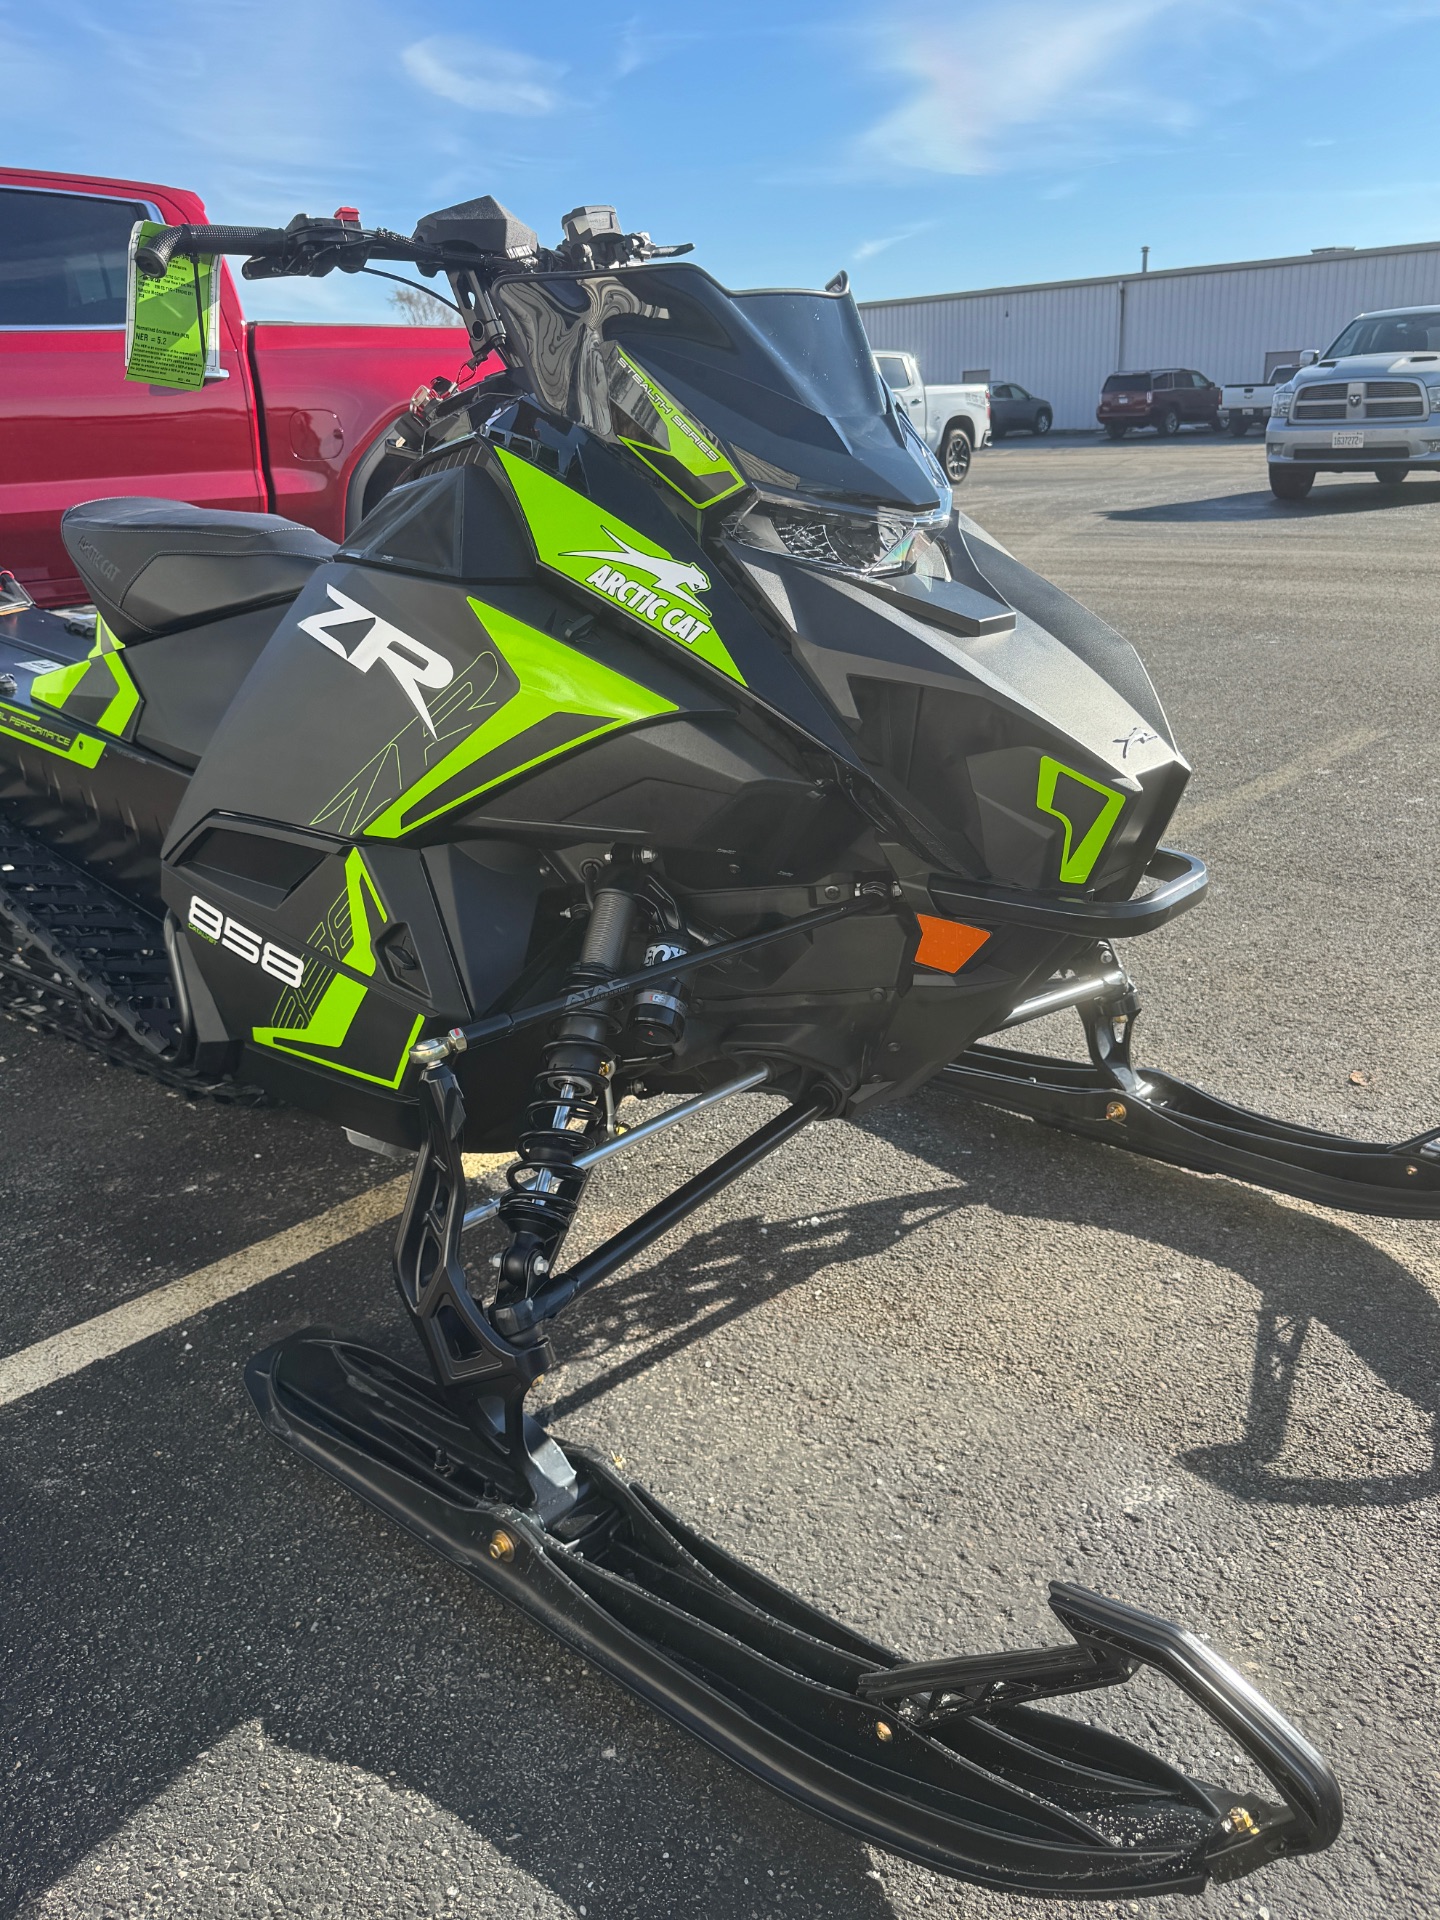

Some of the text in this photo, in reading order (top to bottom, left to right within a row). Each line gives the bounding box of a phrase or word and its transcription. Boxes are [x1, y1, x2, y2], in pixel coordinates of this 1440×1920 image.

[136, 332, 149, 341] NER
[157, 336, 167, 345] 5.2
[617, 357, 719, 462] STEALTH SERIES
[585, 564, 712, 644] ARCTIC CAT
[297, 583, 454, 741] ZR
[9, 715, 71, 746] PERFORMANCE
[187, 922, 218, 945] CATALYST
[188, 895, 305, 988] 858
[565, 979, 629, 1006] ATAC
